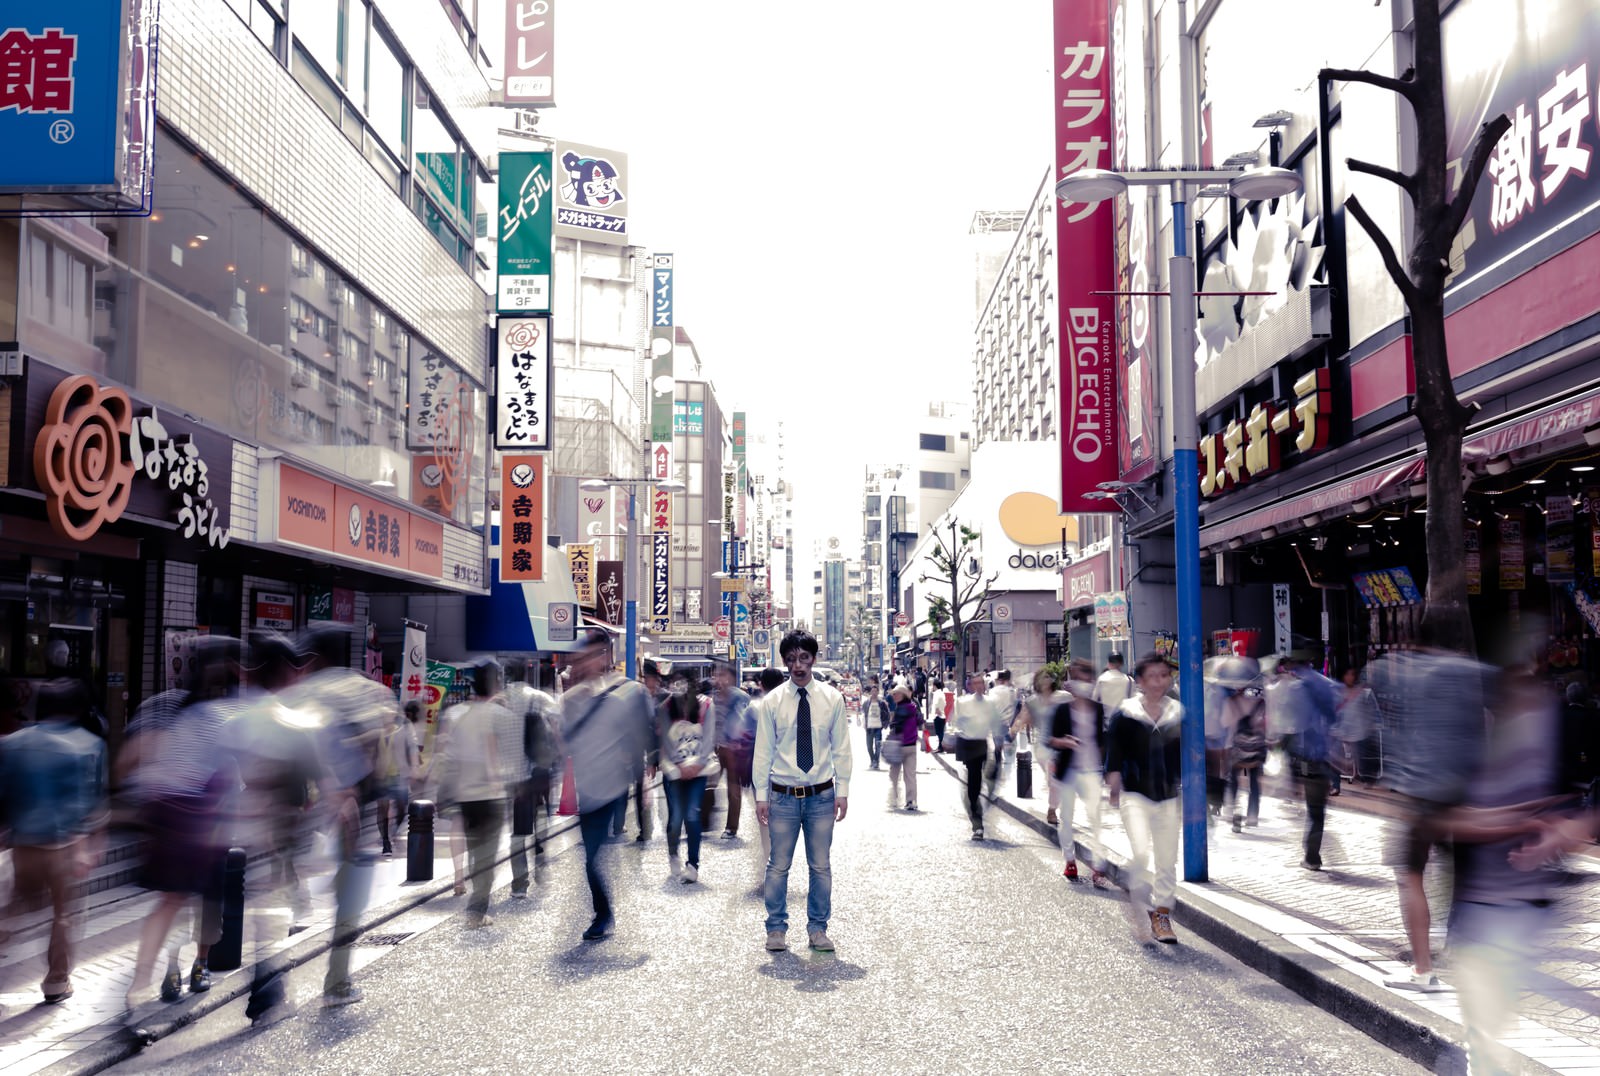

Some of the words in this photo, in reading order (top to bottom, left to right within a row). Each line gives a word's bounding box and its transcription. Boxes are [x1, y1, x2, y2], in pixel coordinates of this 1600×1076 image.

[558, 210, 626, 233] メガネドラッグ
[515, 297, 531, 306] 3F
[655, 271, 670, 326] マインズ
[1069, 307, 1099, 366] BIG
[1102, 320, 1111, 364] Karaoke
[511, 350, 539, 427] はなまる
[1103, 368, 1113, 446] Entertainment
[505, 397, 528, 441] うどん
[1072, 373, 1102, 463] ECHO
[130, 406, 209, 498] はなまる
[177, 492, 231, 550] うどん
[287, 495, 327, 524] YOSHINOYA
[571, 550, 590, 583] 大黒屋
[654, 532, 669, 616] メガネドラッグ
[1008, 548, 1060, 570] daiei
